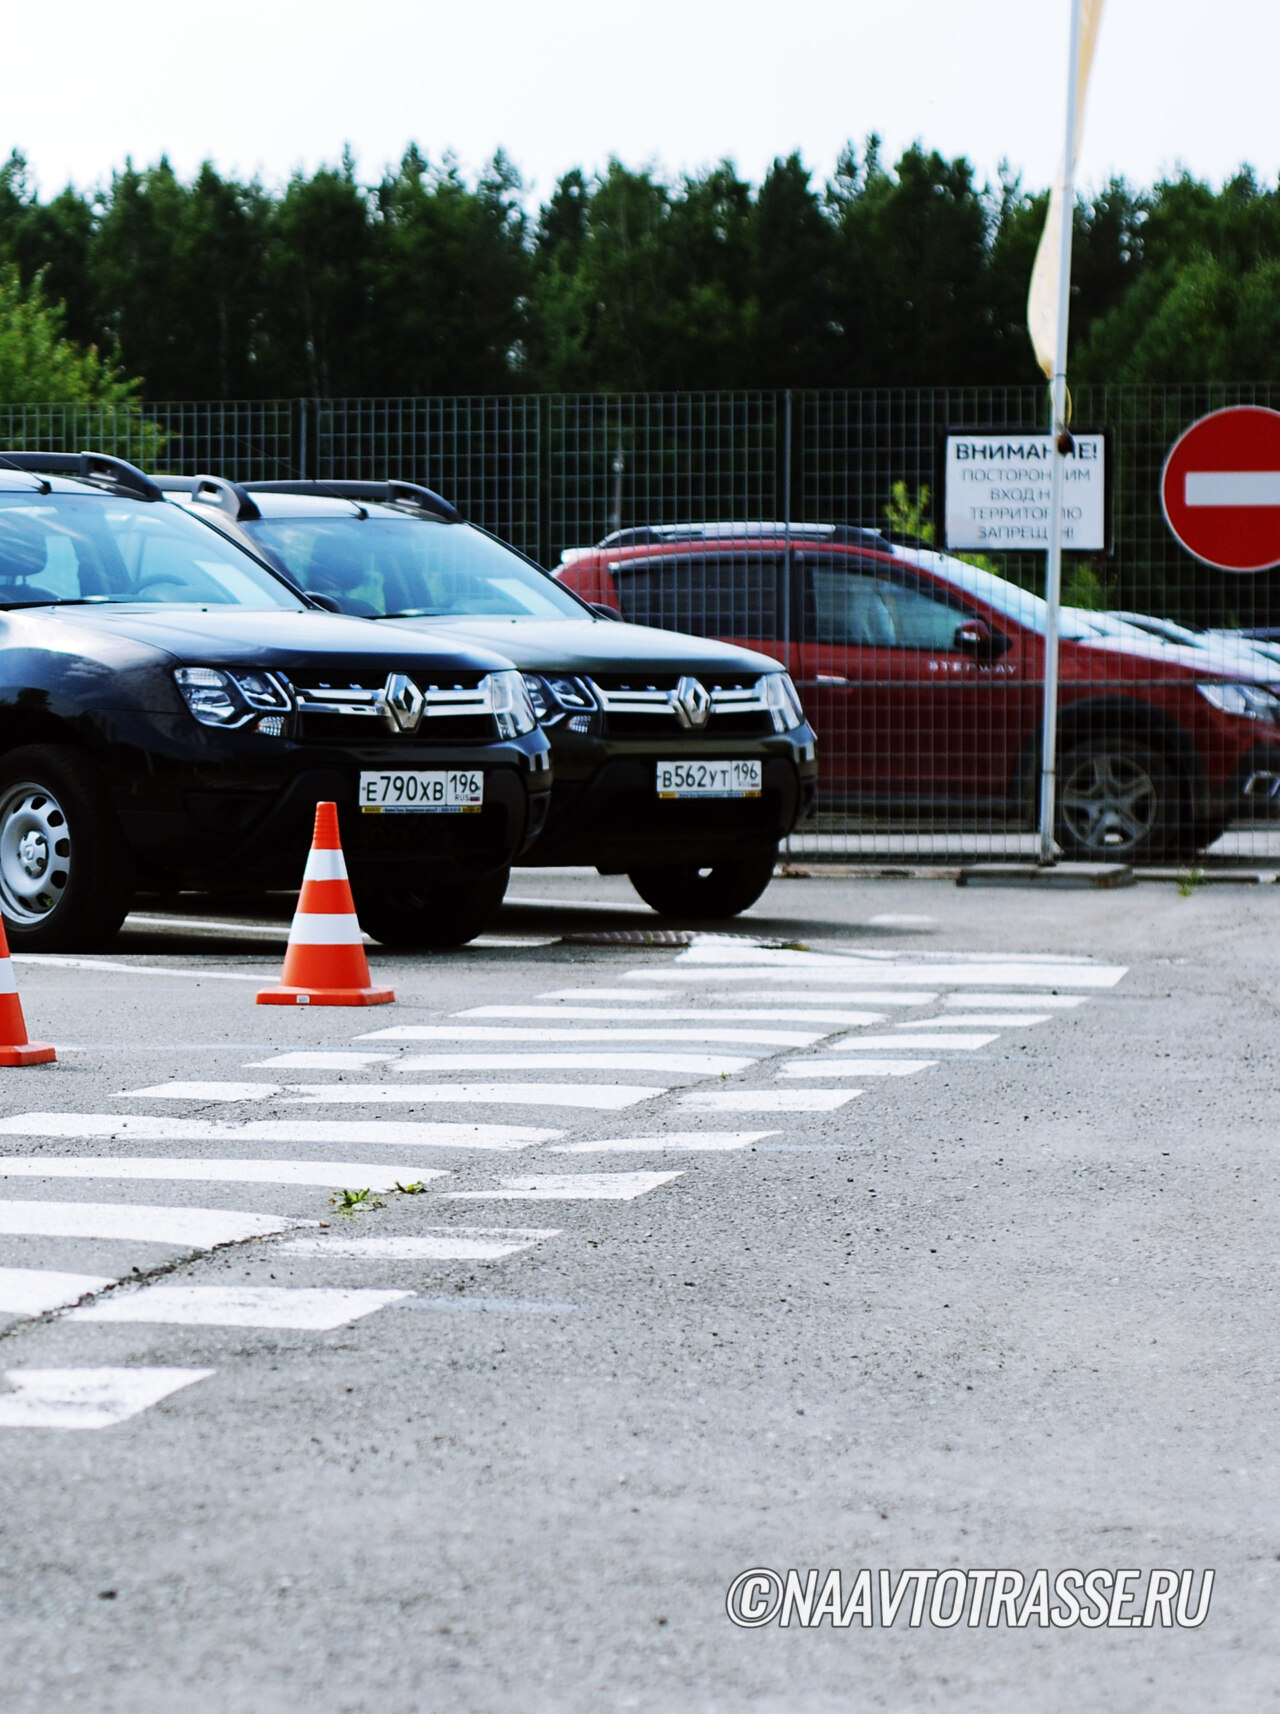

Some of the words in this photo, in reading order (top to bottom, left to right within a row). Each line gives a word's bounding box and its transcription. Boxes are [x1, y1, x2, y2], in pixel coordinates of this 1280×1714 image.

[962, 468, 1091, 482] ПОСТОРОНИМ
[990, 487, 1035, 503] ВХОД
[978, 525, 1074, 540] ЗАПРЕЩН!
[734, 763, 759, 780] 196
[450, 774, 478, 794] 196
